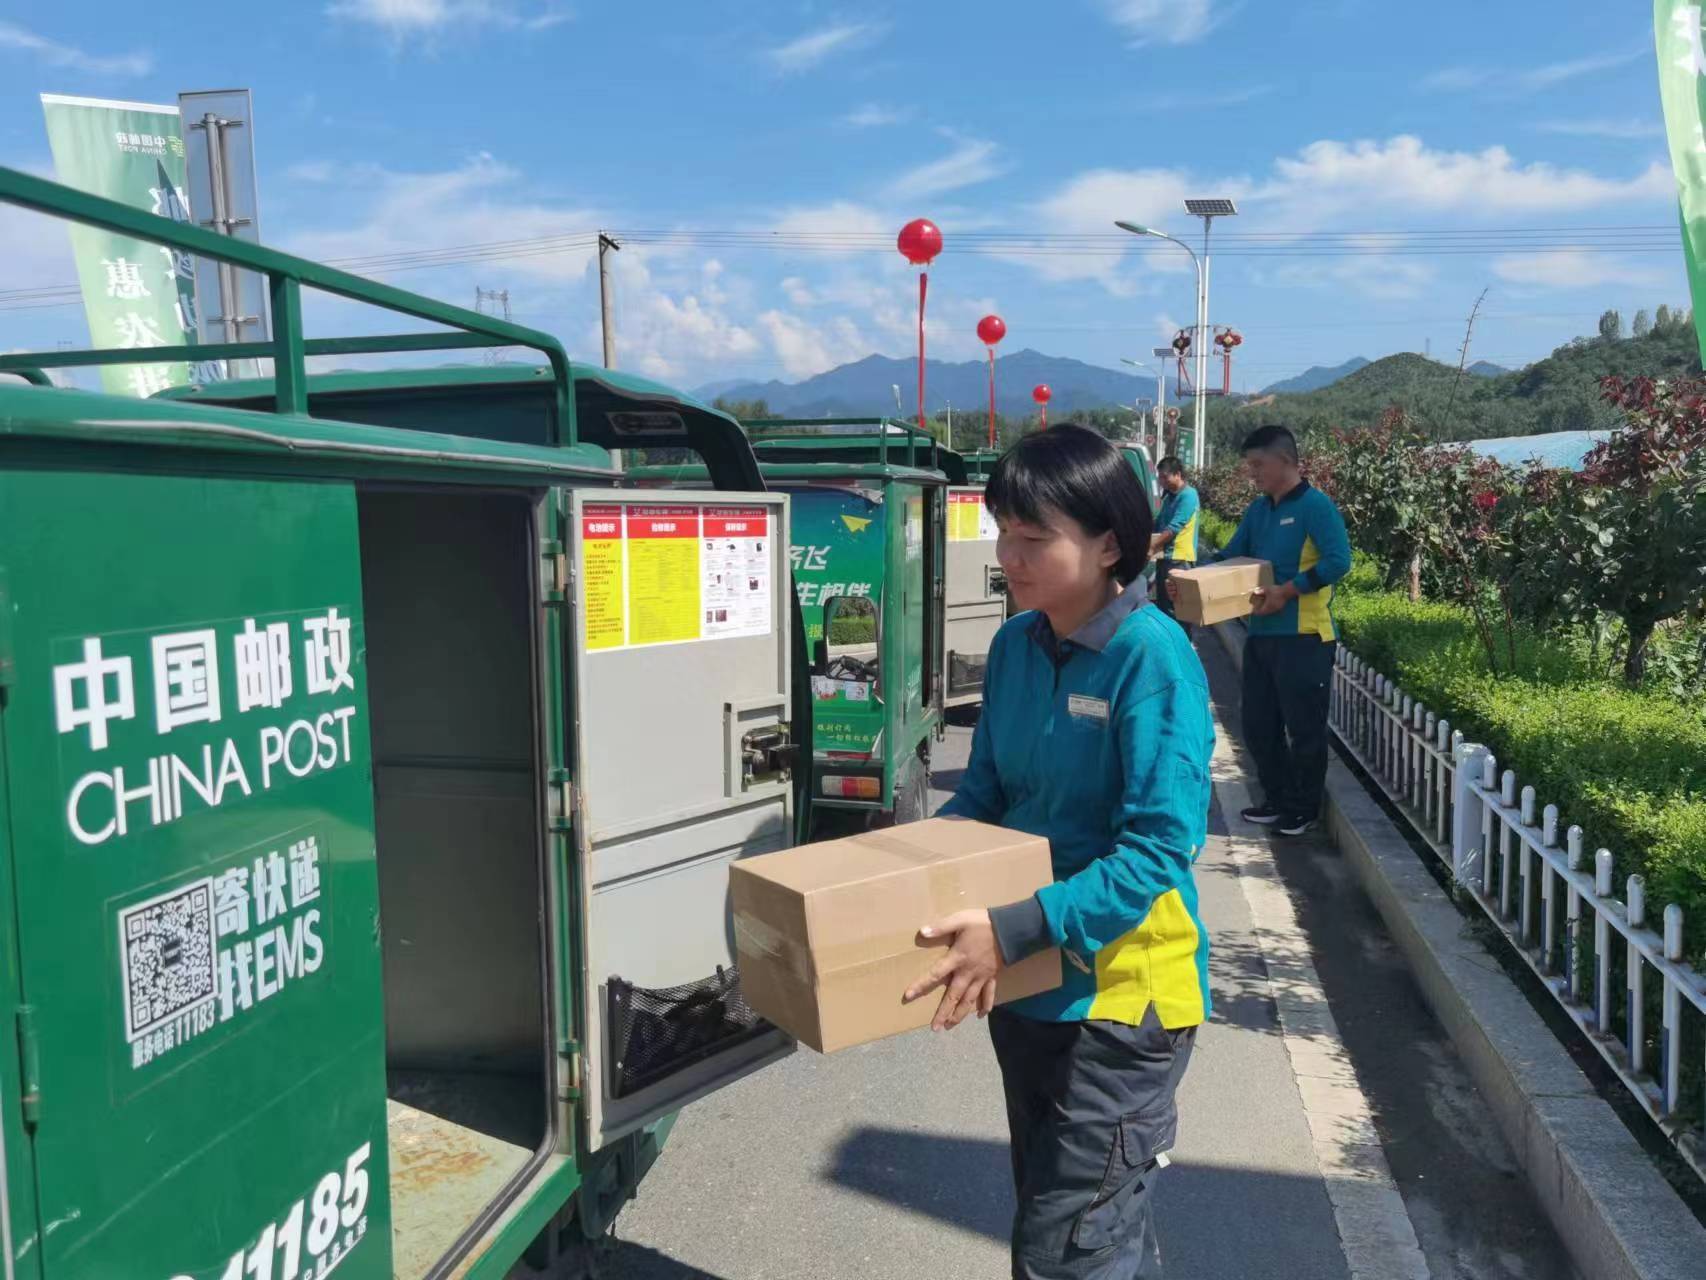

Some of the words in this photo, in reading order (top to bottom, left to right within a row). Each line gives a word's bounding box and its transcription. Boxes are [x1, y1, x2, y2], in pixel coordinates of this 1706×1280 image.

[53, 607, 354, 751] 中国邮政
[67, 738, 251, 844] CHINA
[260, 706, 356, 788] POST
[213, 836, 320, 937] 寄快递
